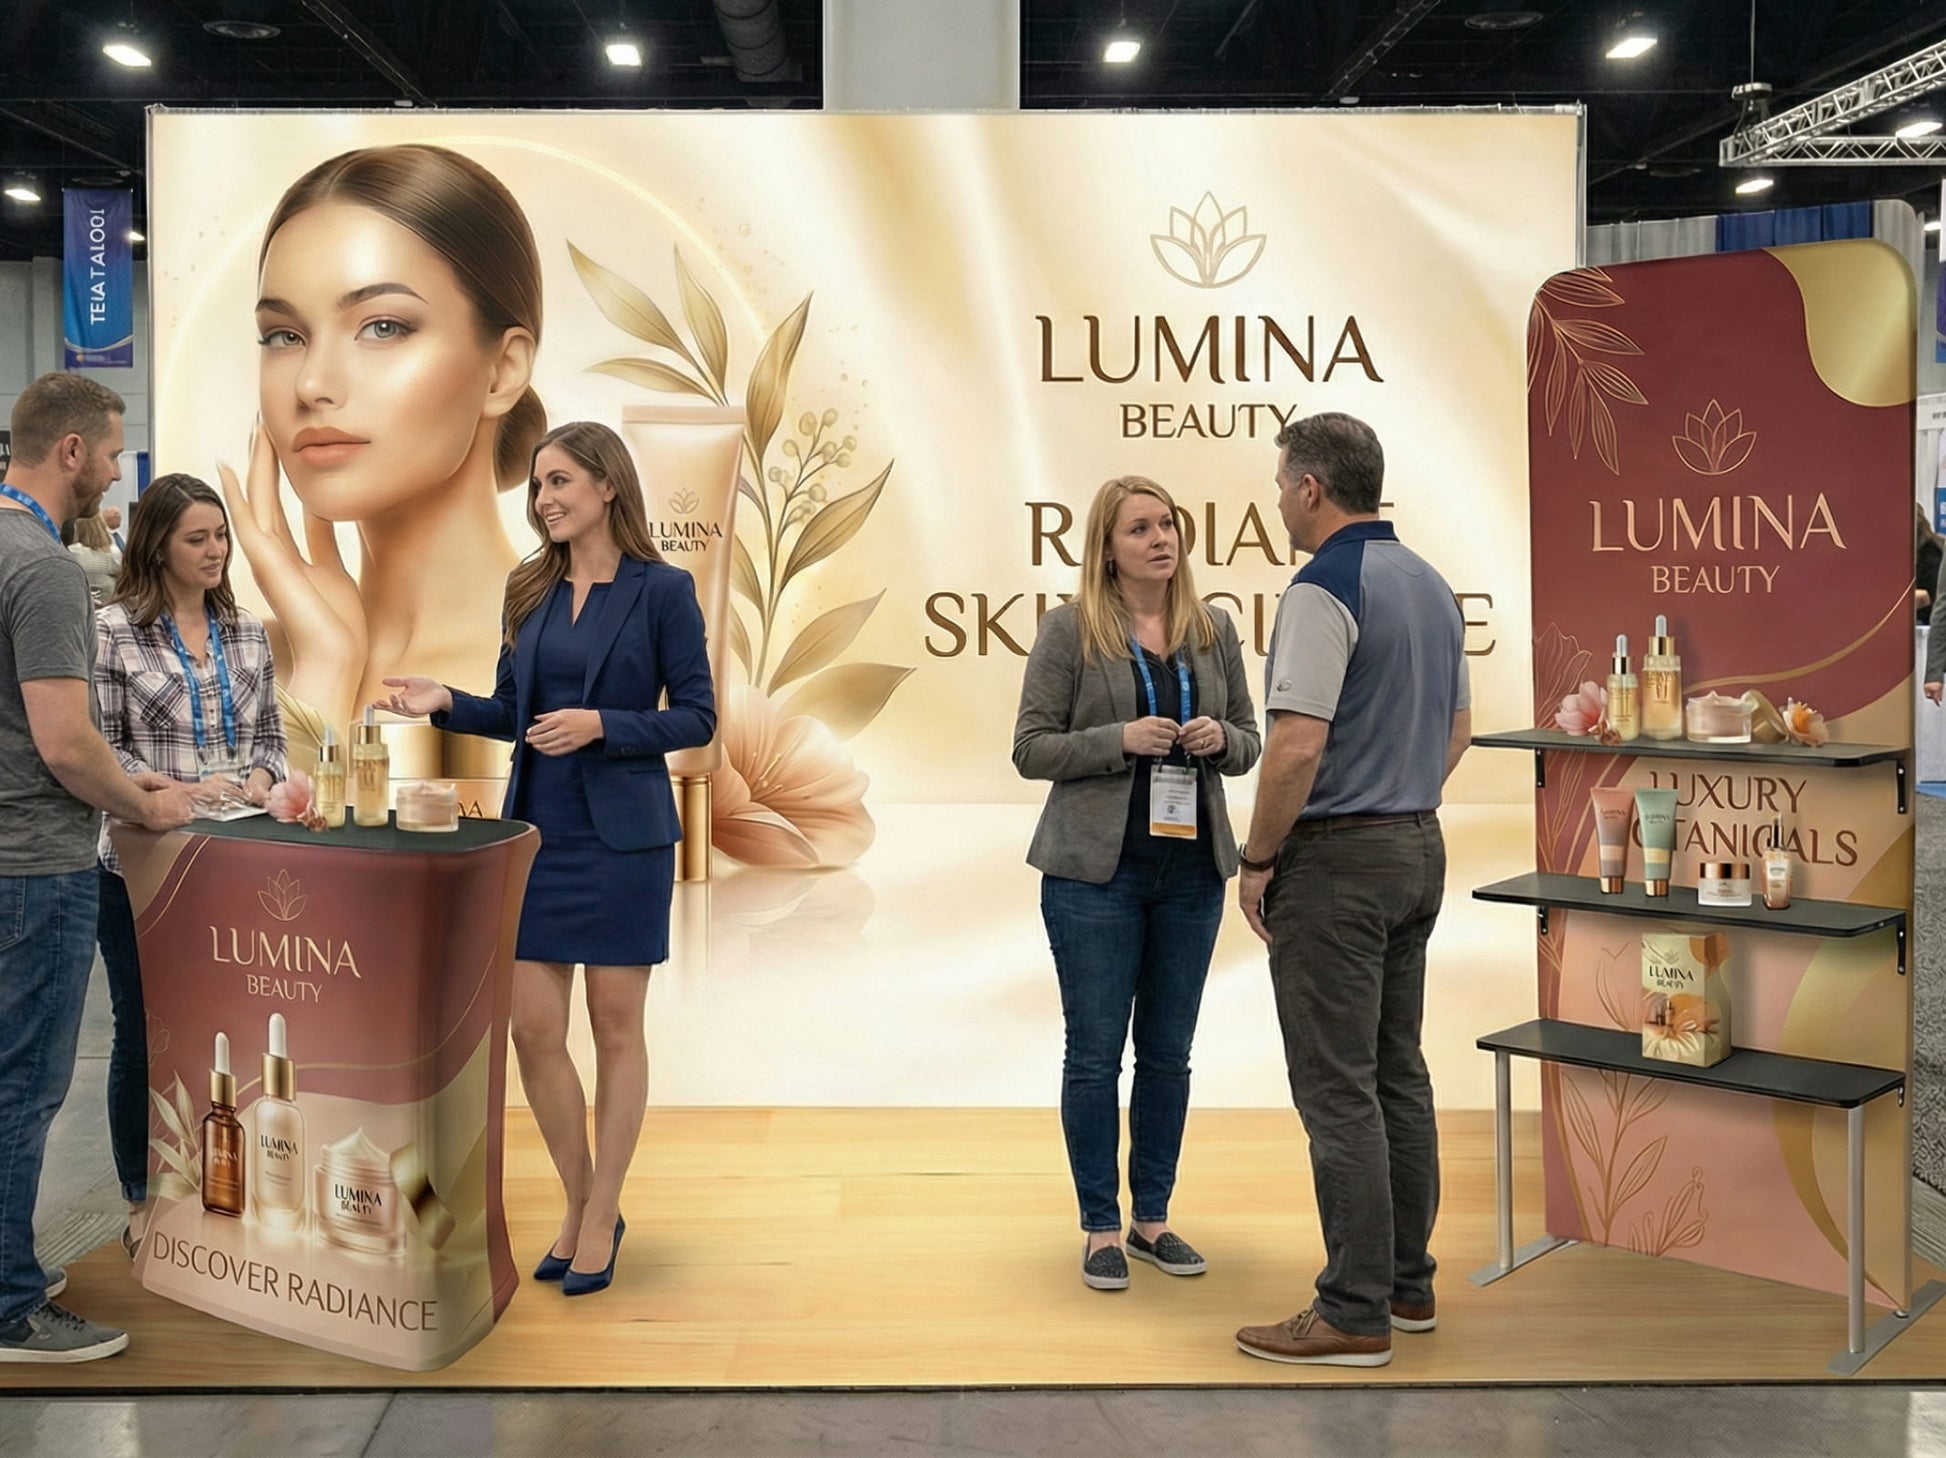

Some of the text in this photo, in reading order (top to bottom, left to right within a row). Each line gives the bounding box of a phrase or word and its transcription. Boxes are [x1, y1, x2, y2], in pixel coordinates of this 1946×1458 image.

[1035, 314, 1385, 384] LUMINA
[1119, 403, 1298, 439] BEAUTY
[648, 521, 723, 539] LUMINA
[1588, 492, 1848, 552] LUMINA
[661, 539, 710, 552] BEAUTY
[1650, 564, 1781, 594] BEAUTY
[208, 925, 362, 979] LUMINA
[246, 973, 323, 1003] BEAUTY
[334, 1183, 383, 1207] LUMINA
[153, 1230, 438, 1332] DISCOVER RADIANCE
